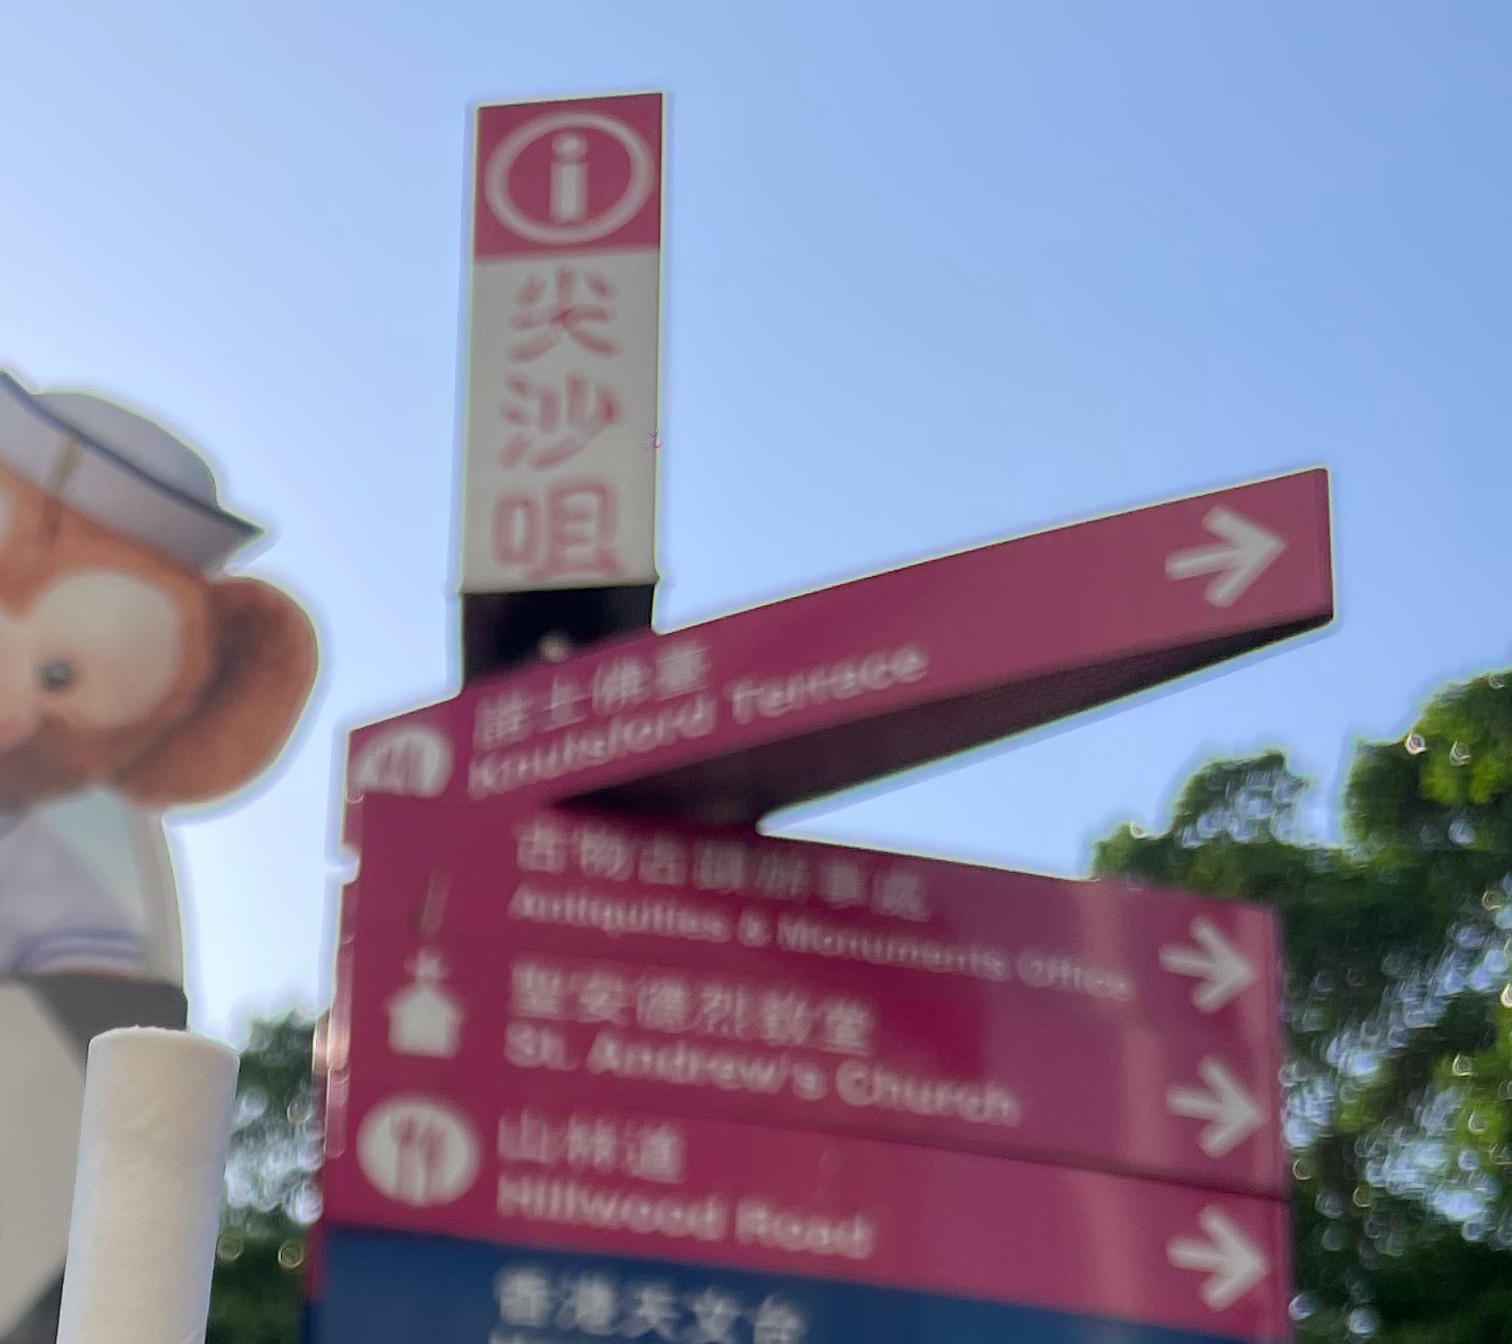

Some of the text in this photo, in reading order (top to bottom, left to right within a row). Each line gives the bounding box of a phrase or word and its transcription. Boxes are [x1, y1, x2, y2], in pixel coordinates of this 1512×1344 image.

[494, 266, 622, 580] 尖沙咀
[836, 1058, 1022, 1127] Church
[735, 1198, 874, 1260] Road
